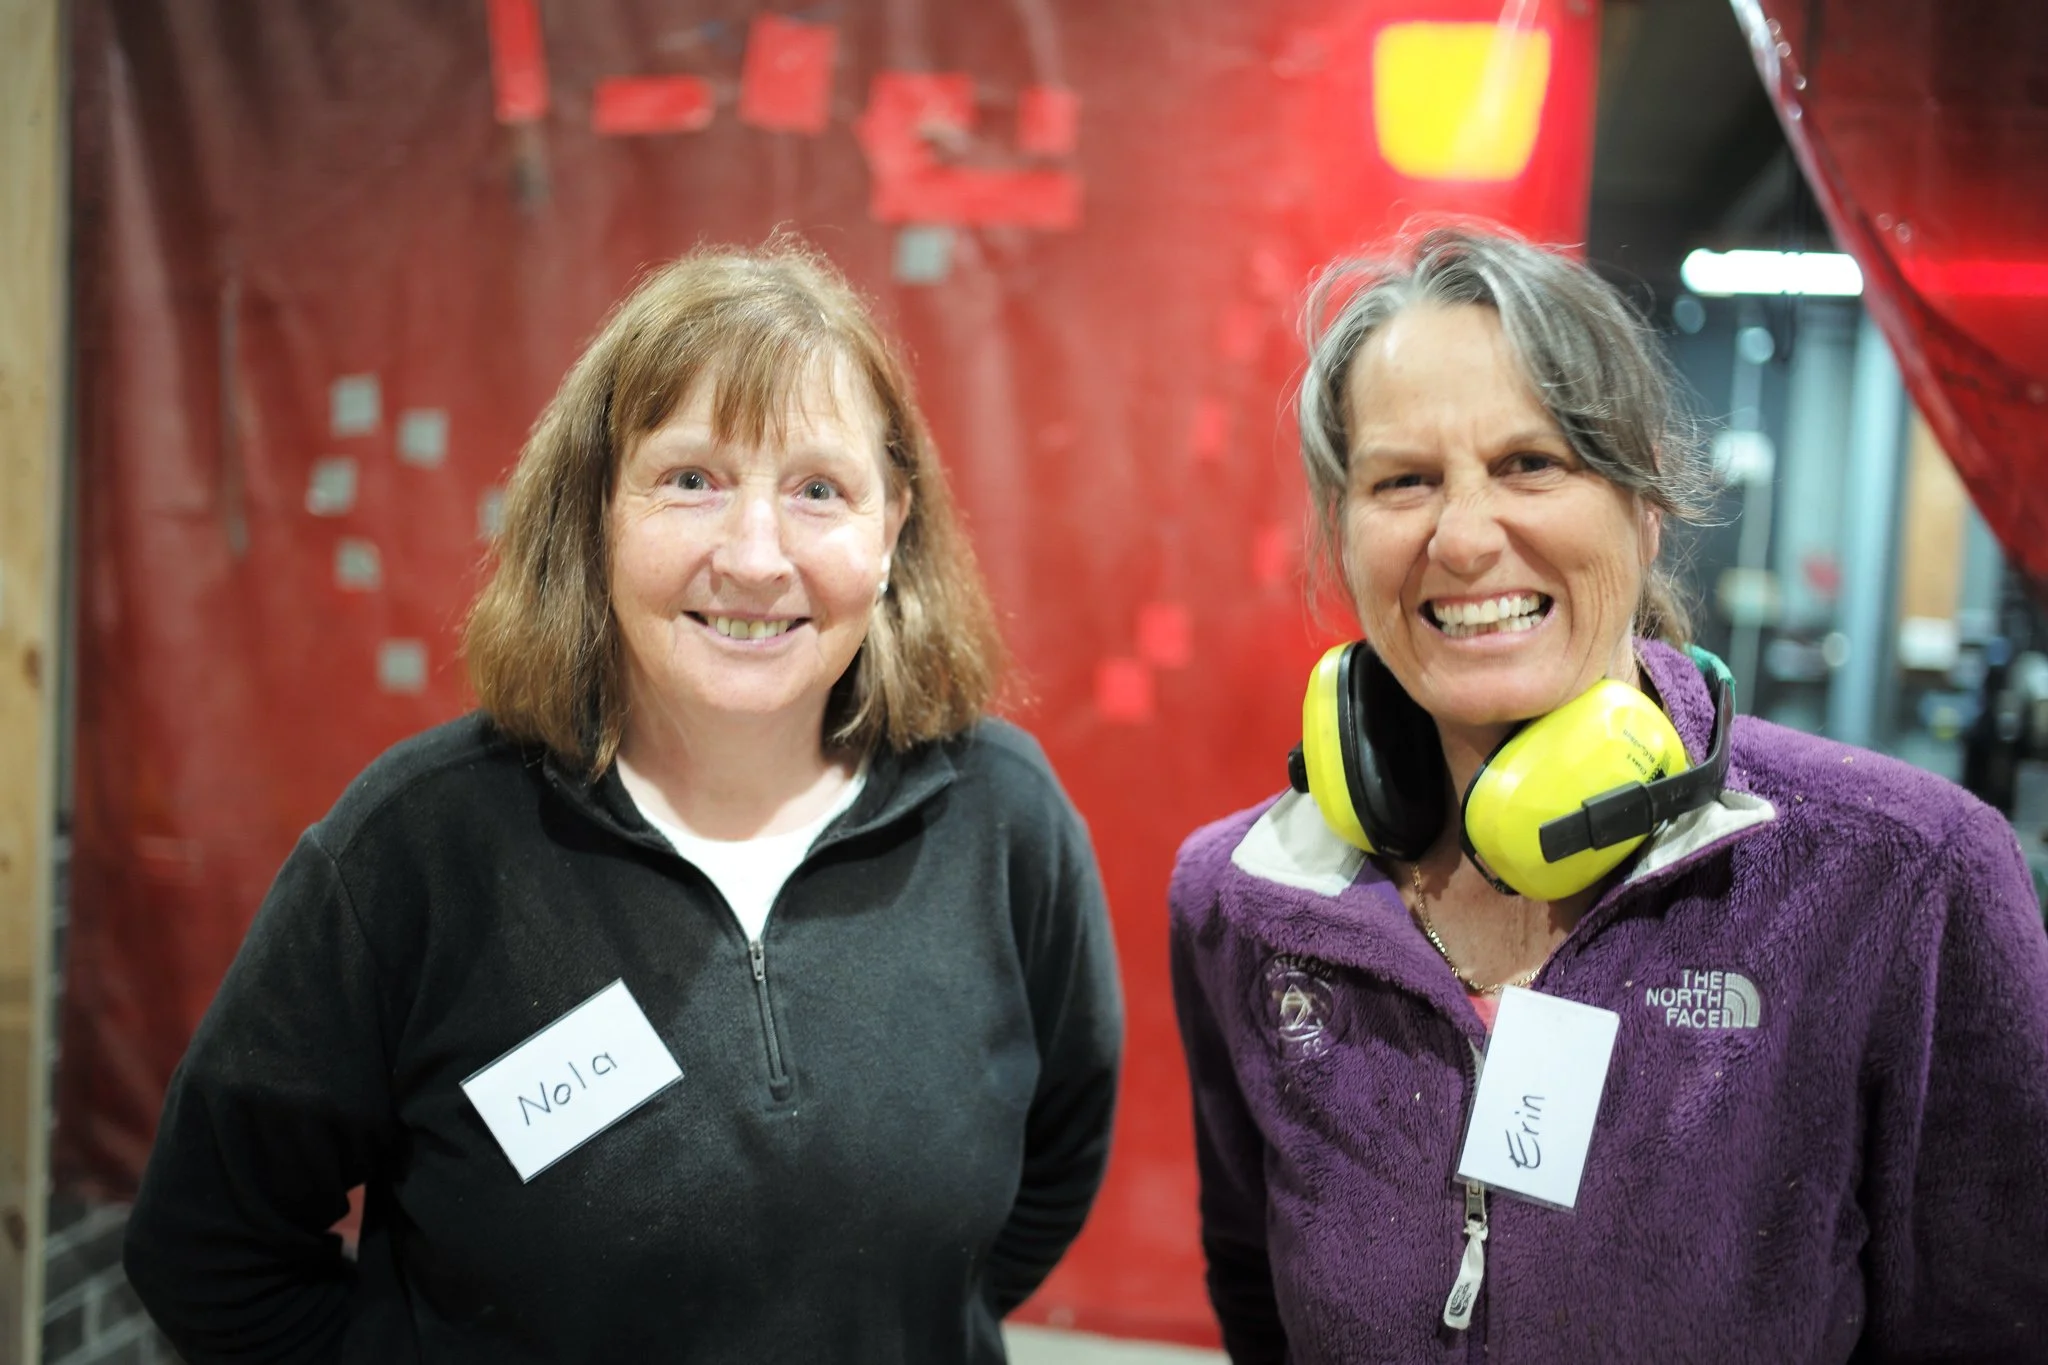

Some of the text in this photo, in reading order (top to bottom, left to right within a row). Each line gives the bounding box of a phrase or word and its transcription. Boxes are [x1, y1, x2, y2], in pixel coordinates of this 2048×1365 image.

[1682, 968, 1723, 990] THE
[1646, 987, 1722, 1009] NORTH
[1666, 1007, 1721, 1029] FACE
[518, 1052, 618, 1127] Nola
[1505, 1094, 1546, 1170] Erin
